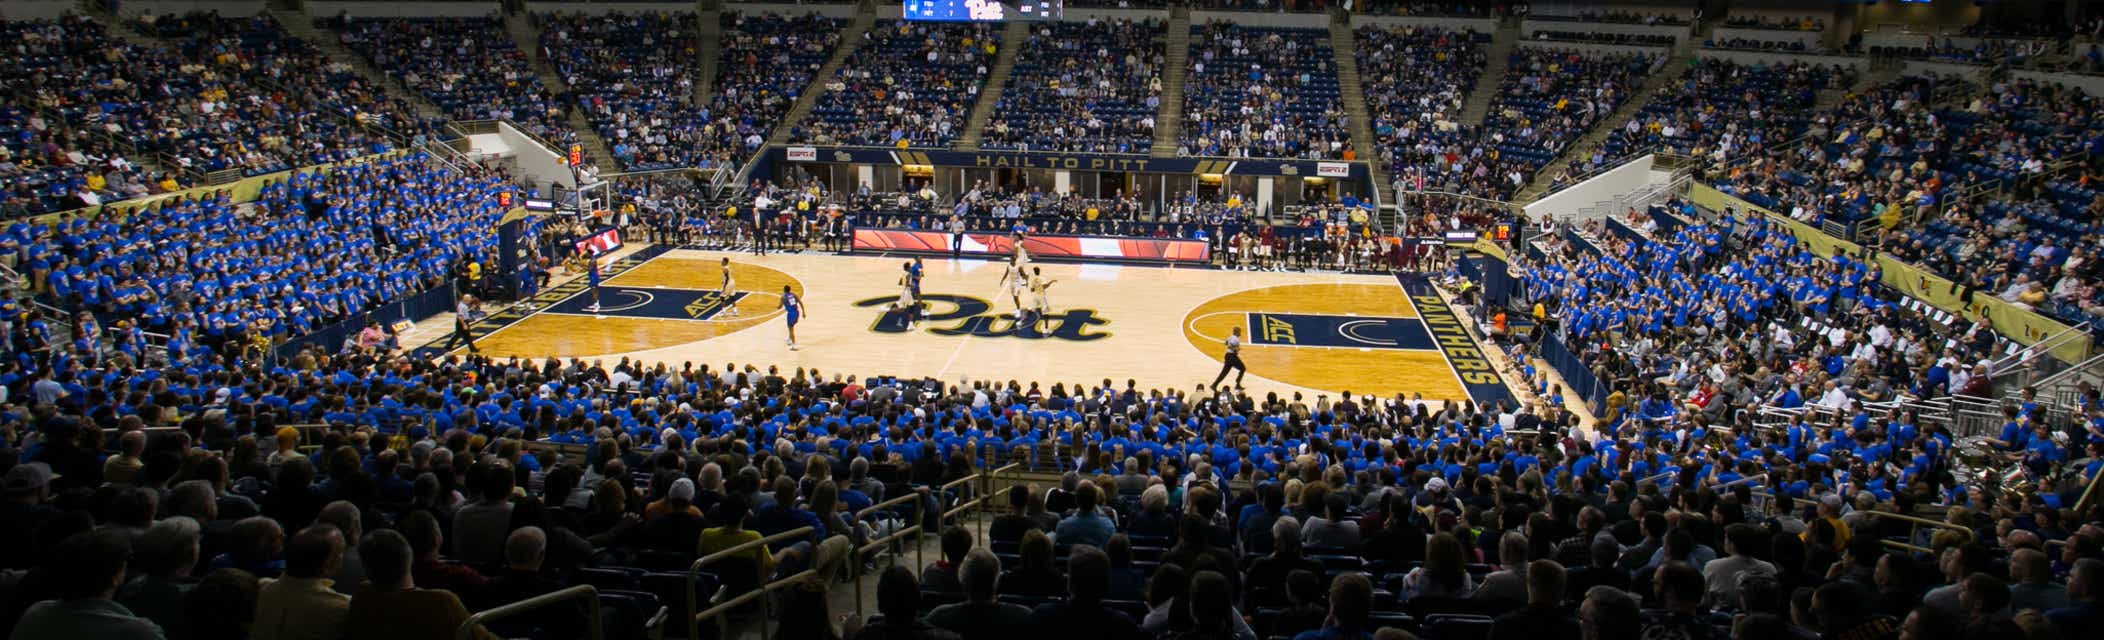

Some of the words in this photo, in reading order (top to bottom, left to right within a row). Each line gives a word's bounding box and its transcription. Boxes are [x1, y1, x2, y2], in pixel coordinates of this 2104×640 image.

[976, 155, 1035, 167] HAIL
[1046, 157, 1079, 169] TO
[1091, 159, 1149, 171] PITT
[851, 294, 1113, 341] Pitt
[1267, 315, 1296, 345] ACC
[1412, 295, 1500, 386] PANTHERS
